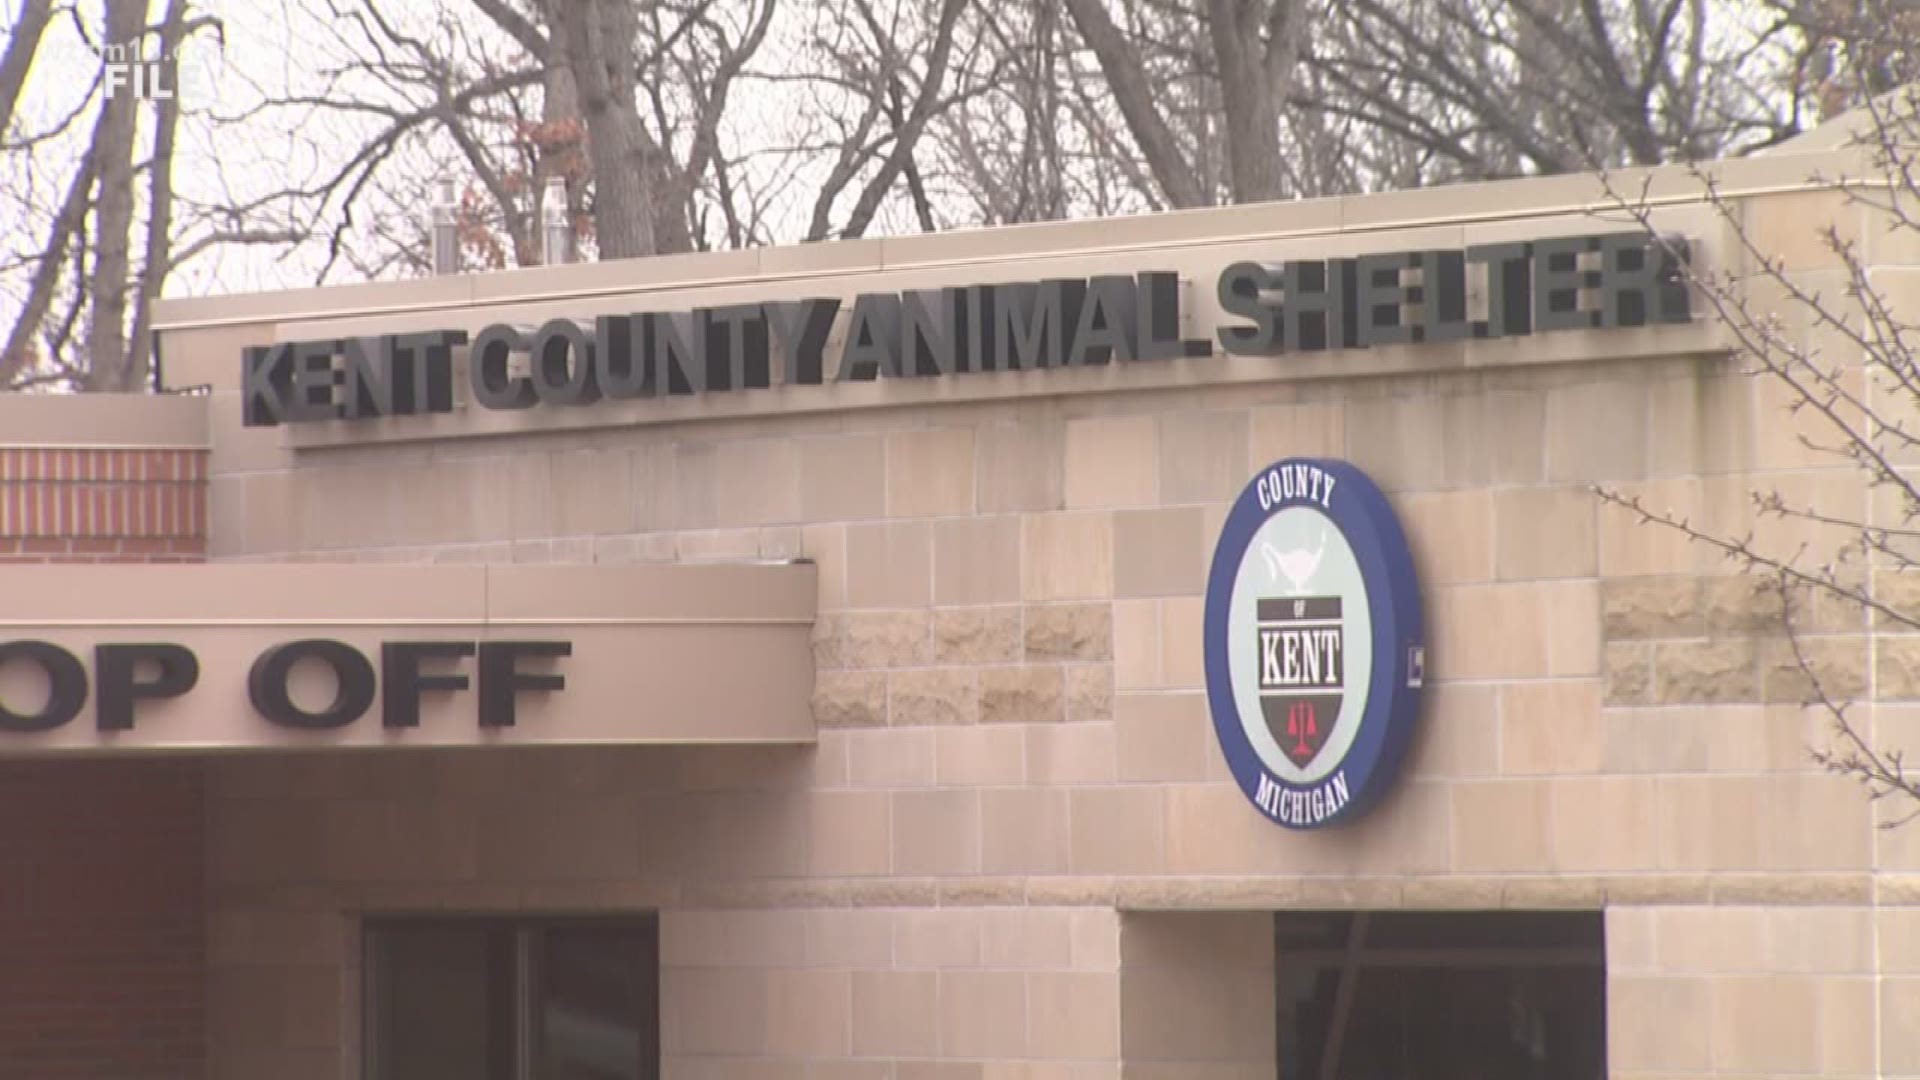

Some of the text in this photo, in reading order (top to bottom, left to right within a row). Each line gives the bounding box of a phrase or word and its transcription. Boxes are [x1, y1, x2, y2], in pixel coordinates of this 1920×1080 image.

[241, 231, 1692, 427] KENT COUNTY ANIMAL SHELTER
[1256, 463, 1336, 511] COUNTY
[247, 638, 573, 728] OFF
[1260, 628, 1341, 687] KENT
[1254, 769, 1350, 825] MICHIGAN
